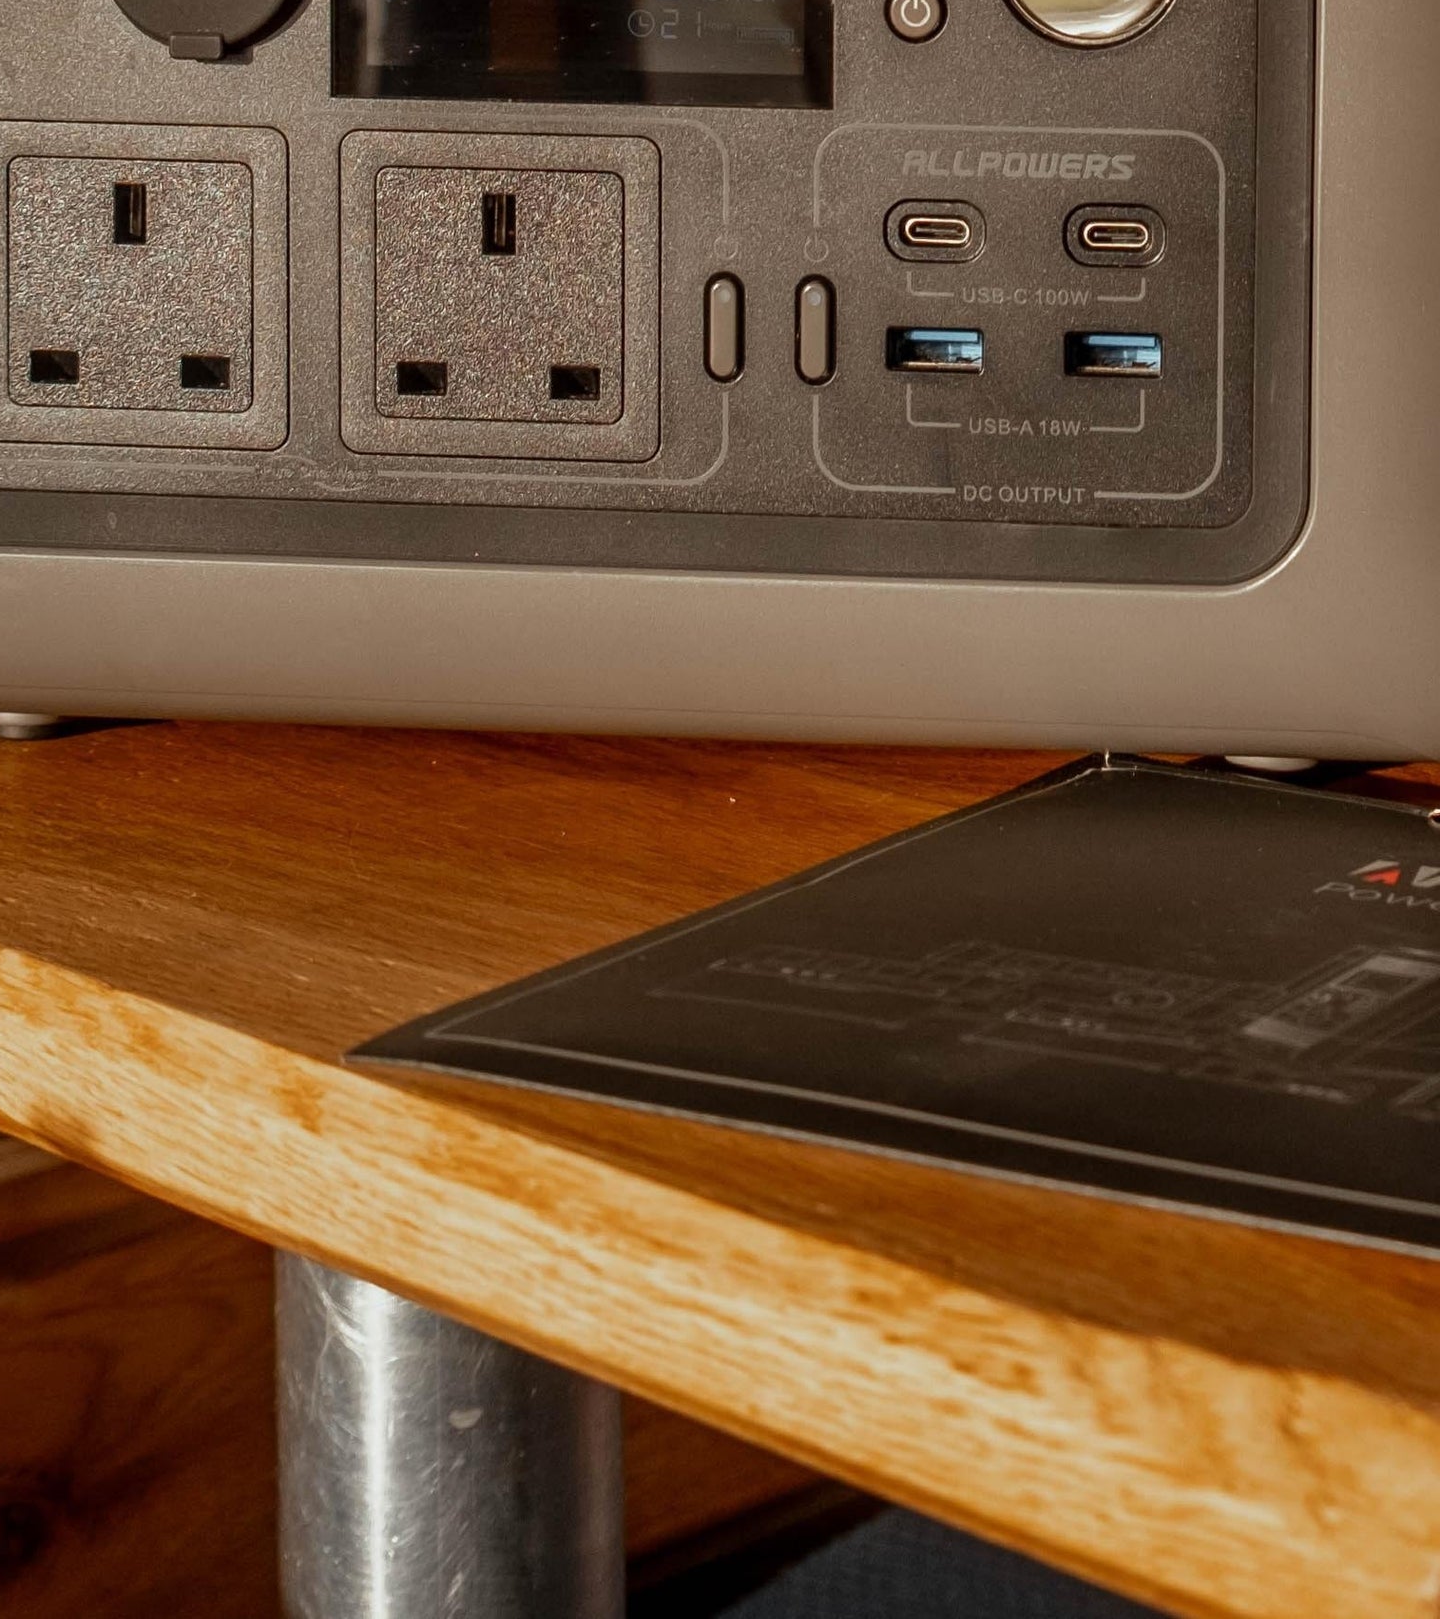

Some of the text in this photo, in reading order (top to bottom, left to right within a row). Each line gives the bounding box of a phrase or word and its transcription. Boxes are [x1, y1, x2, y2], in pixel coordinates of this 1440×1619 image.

[902, 150, 1136, 180] ALLPOWERS
[962, 287, 1090, 306] USB-C 100W
[969, 417, 1081, 436] USB-A 18W
[964, 485, 1086, 504] DC OUTPUT
